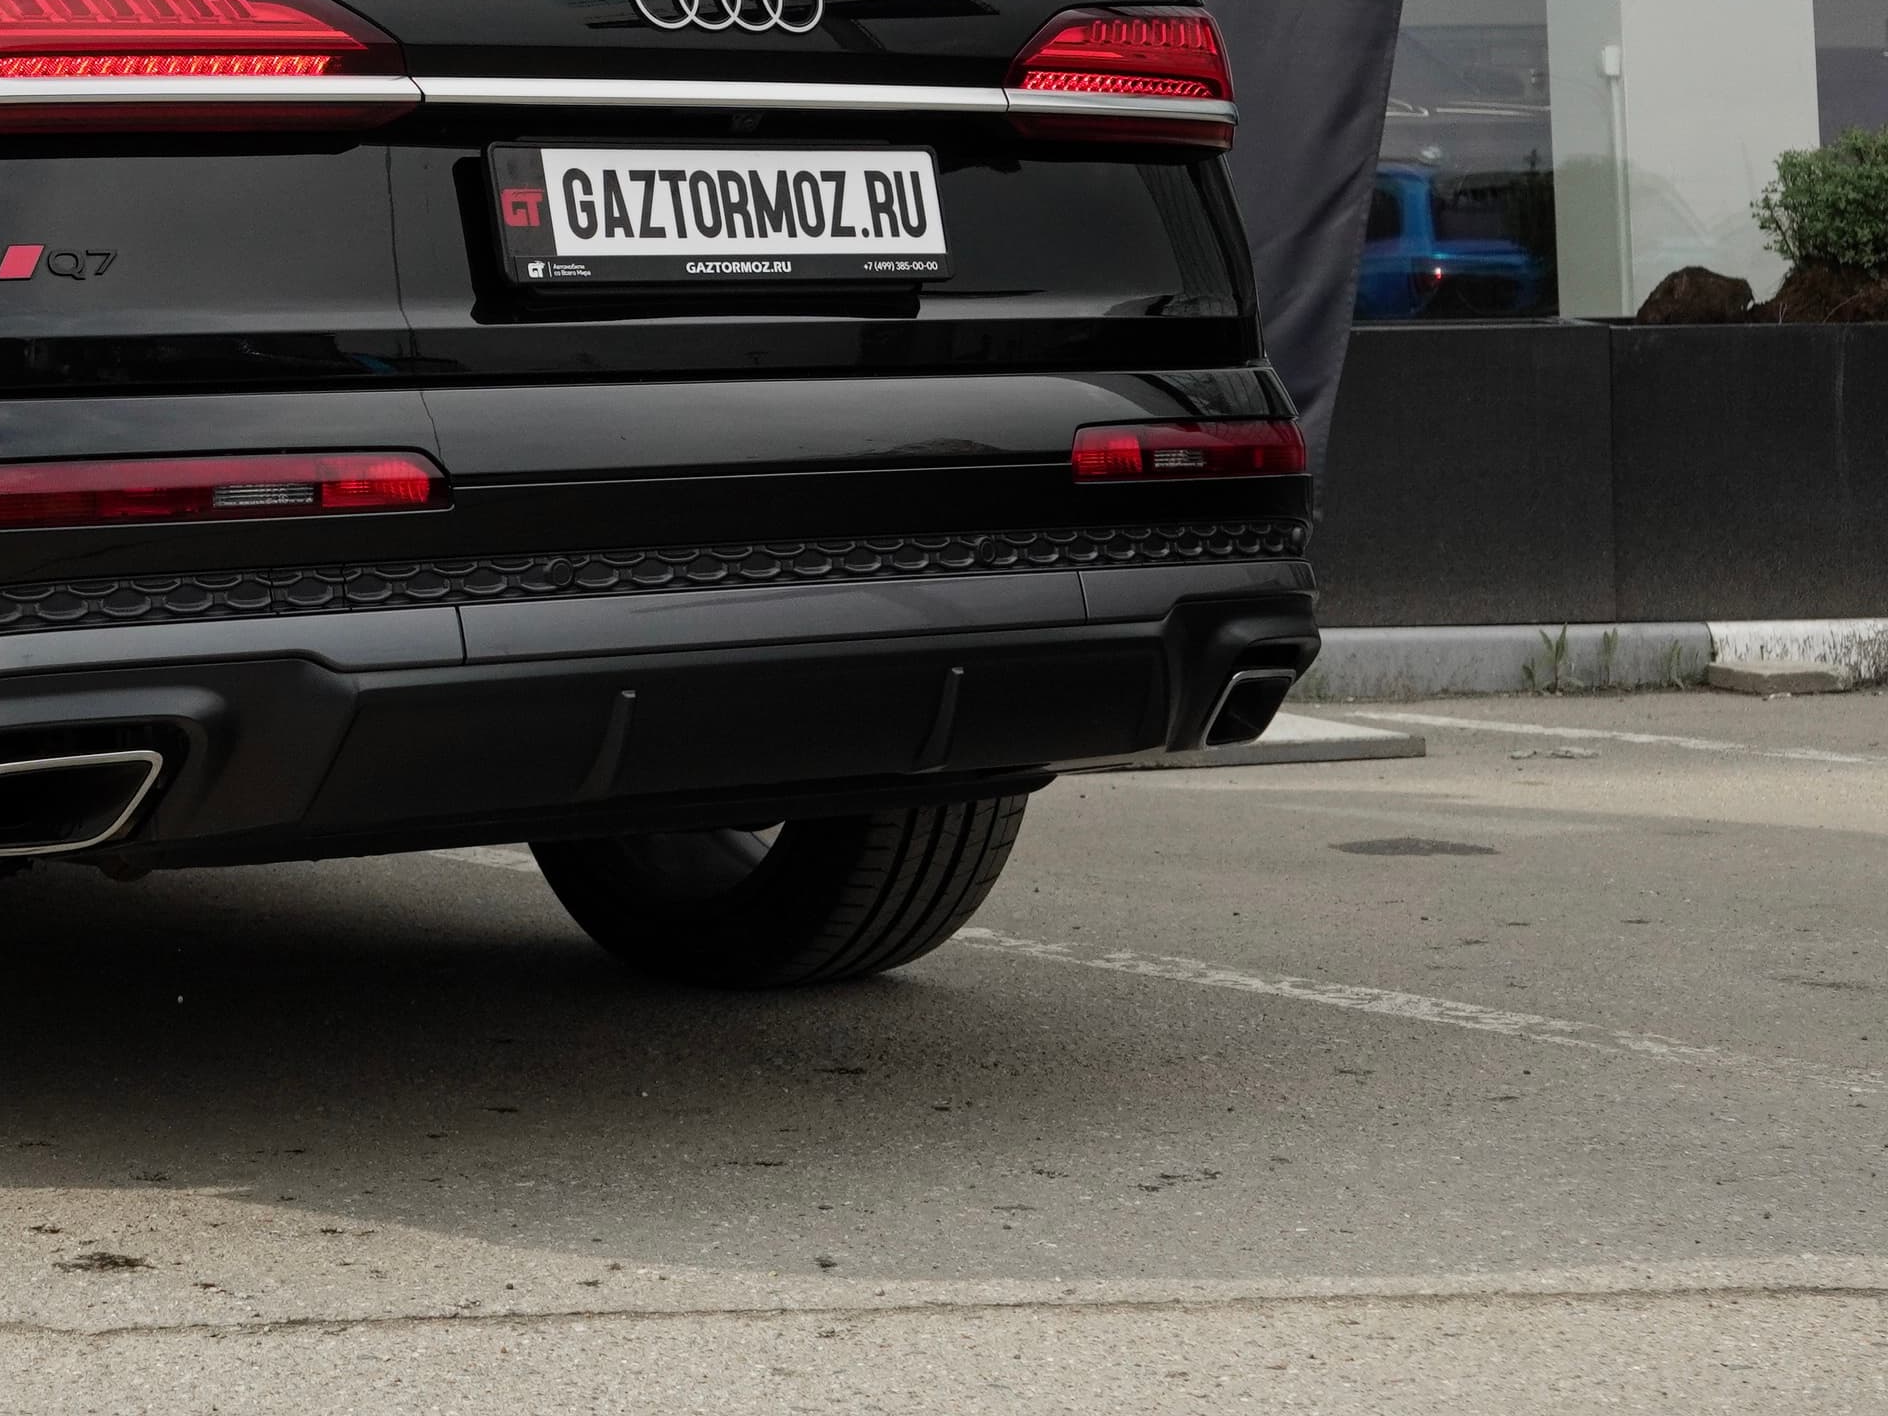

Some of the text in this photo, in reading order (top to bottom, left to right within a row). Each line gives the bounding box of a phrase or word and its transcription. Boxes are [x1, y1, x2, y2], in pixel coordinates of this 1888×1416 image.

[562, 168, 927, 240] GAZTORMOZ.RU
[47, 249, 118, 281] Q7
[686, 261, 792, 274] GAZTORMOZ.RU
